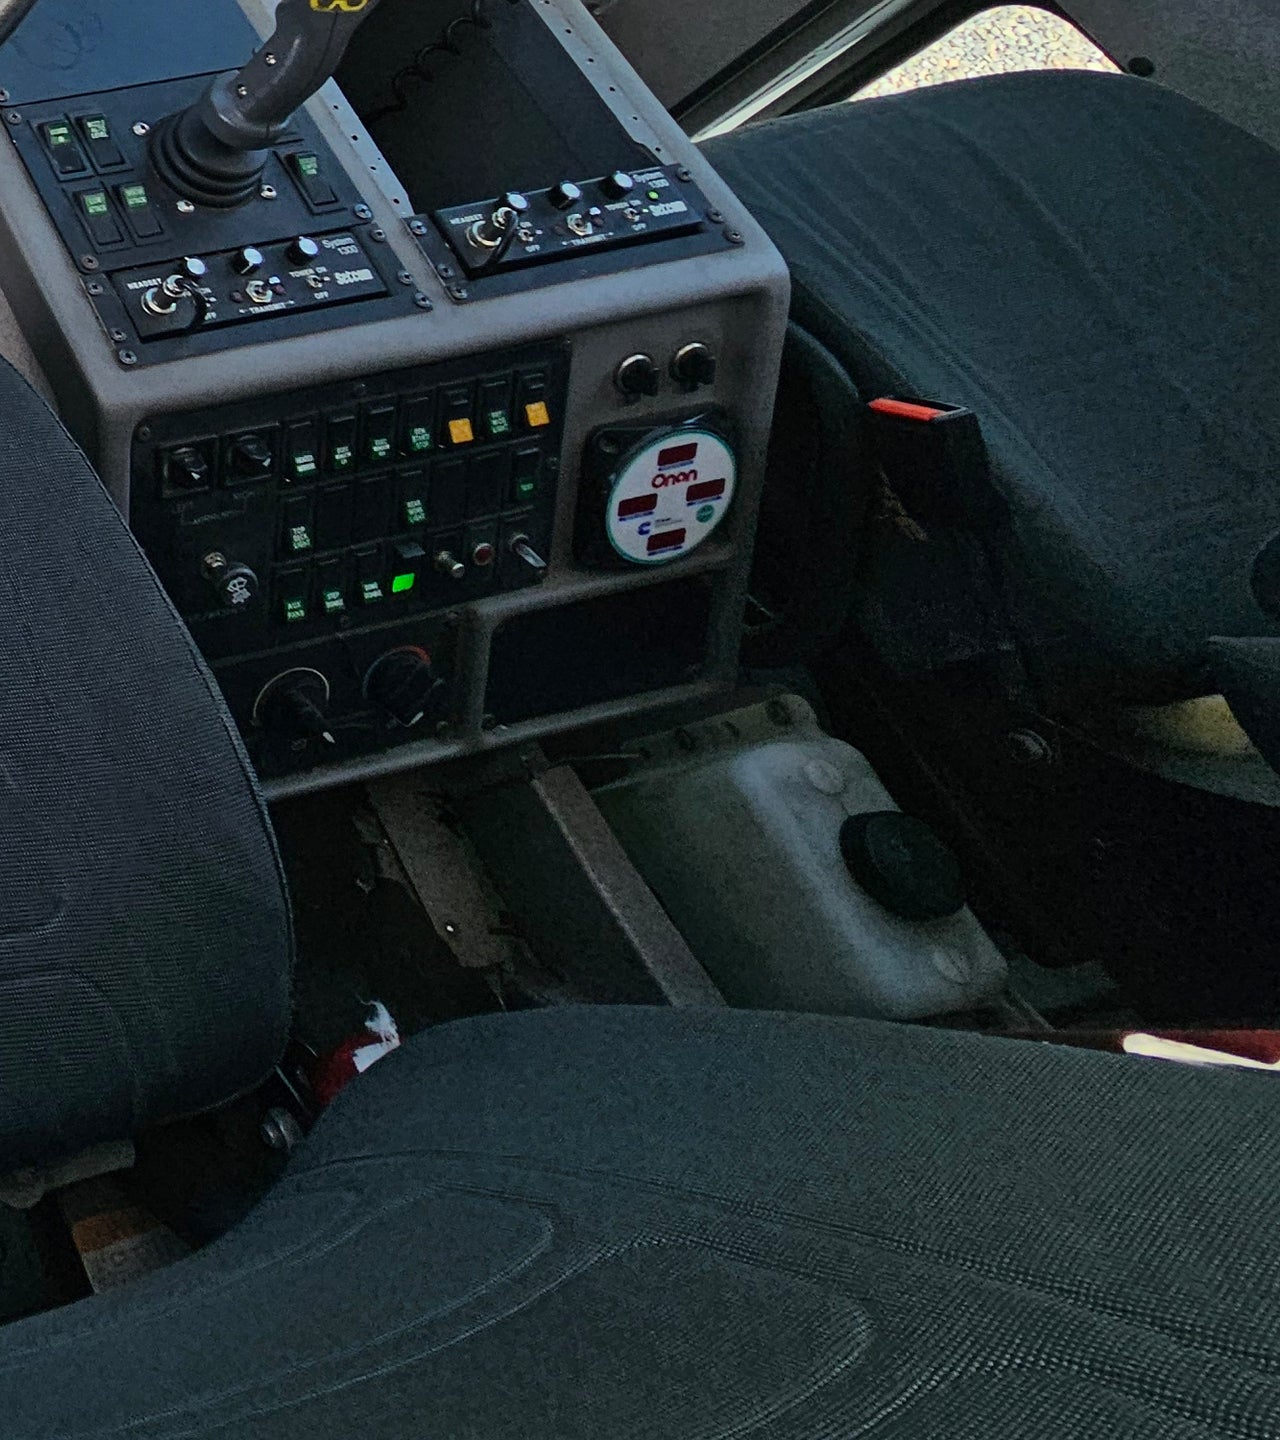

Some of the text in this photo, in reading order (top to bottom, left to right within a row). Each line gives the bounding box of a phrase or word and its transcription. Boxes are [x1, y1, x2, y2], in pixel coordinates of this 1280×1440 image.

[633, 171, 664, 183] System
[449, 214, 484, 225] HEADSET
[322, 237, 354, 249] System
[337, 245, 359, 255] 1300
[525, 245, 541, 253] OFF
[127, 278, 163, 290] HEADSET
[314, 291, 329, 300] OFF
[652, 469, 698, 489] Onan
